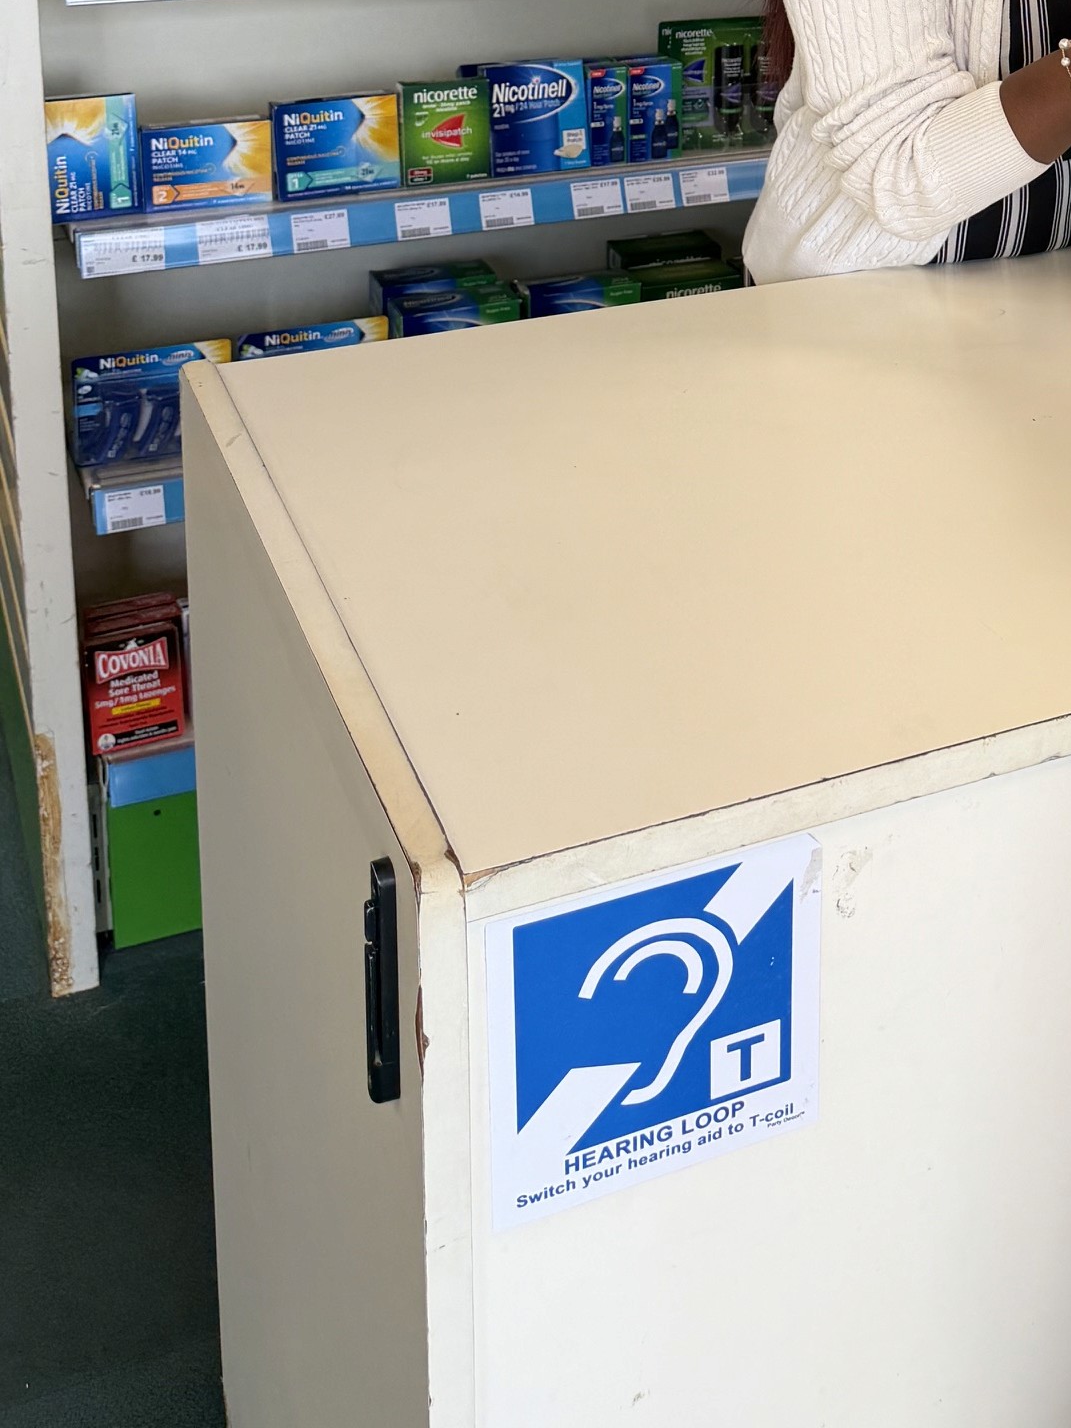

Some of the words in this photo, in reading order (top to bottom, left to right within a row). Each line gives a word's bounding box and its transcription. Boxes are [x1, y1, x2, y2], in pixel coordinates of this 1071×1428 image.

[414, 86, 477, 102] nicorette
[492, 80, 566, 103] Nicotinell
[284, 111, 343, 126] NiQuitin
[151, 136, 214, 151] NiQuitin
[56, 156, 67, 215] NiQuitin
[99, 643, 165, 677] COVONIA
[727, 1033, 764, 1081] T
[565, 1127, 673, 1174] HEARING
[681, 1101, 745, 1136] LOOP
[517, 1179, 576, 1208] Switch
[582, 1163, 623, 1188] your
[628, 1138, 692, 1171] hearing
[697, 1127, 723, 1147] aid
[728, 1122, 744, 1136] to
[749, 1103, 794, 1128] T-coil
